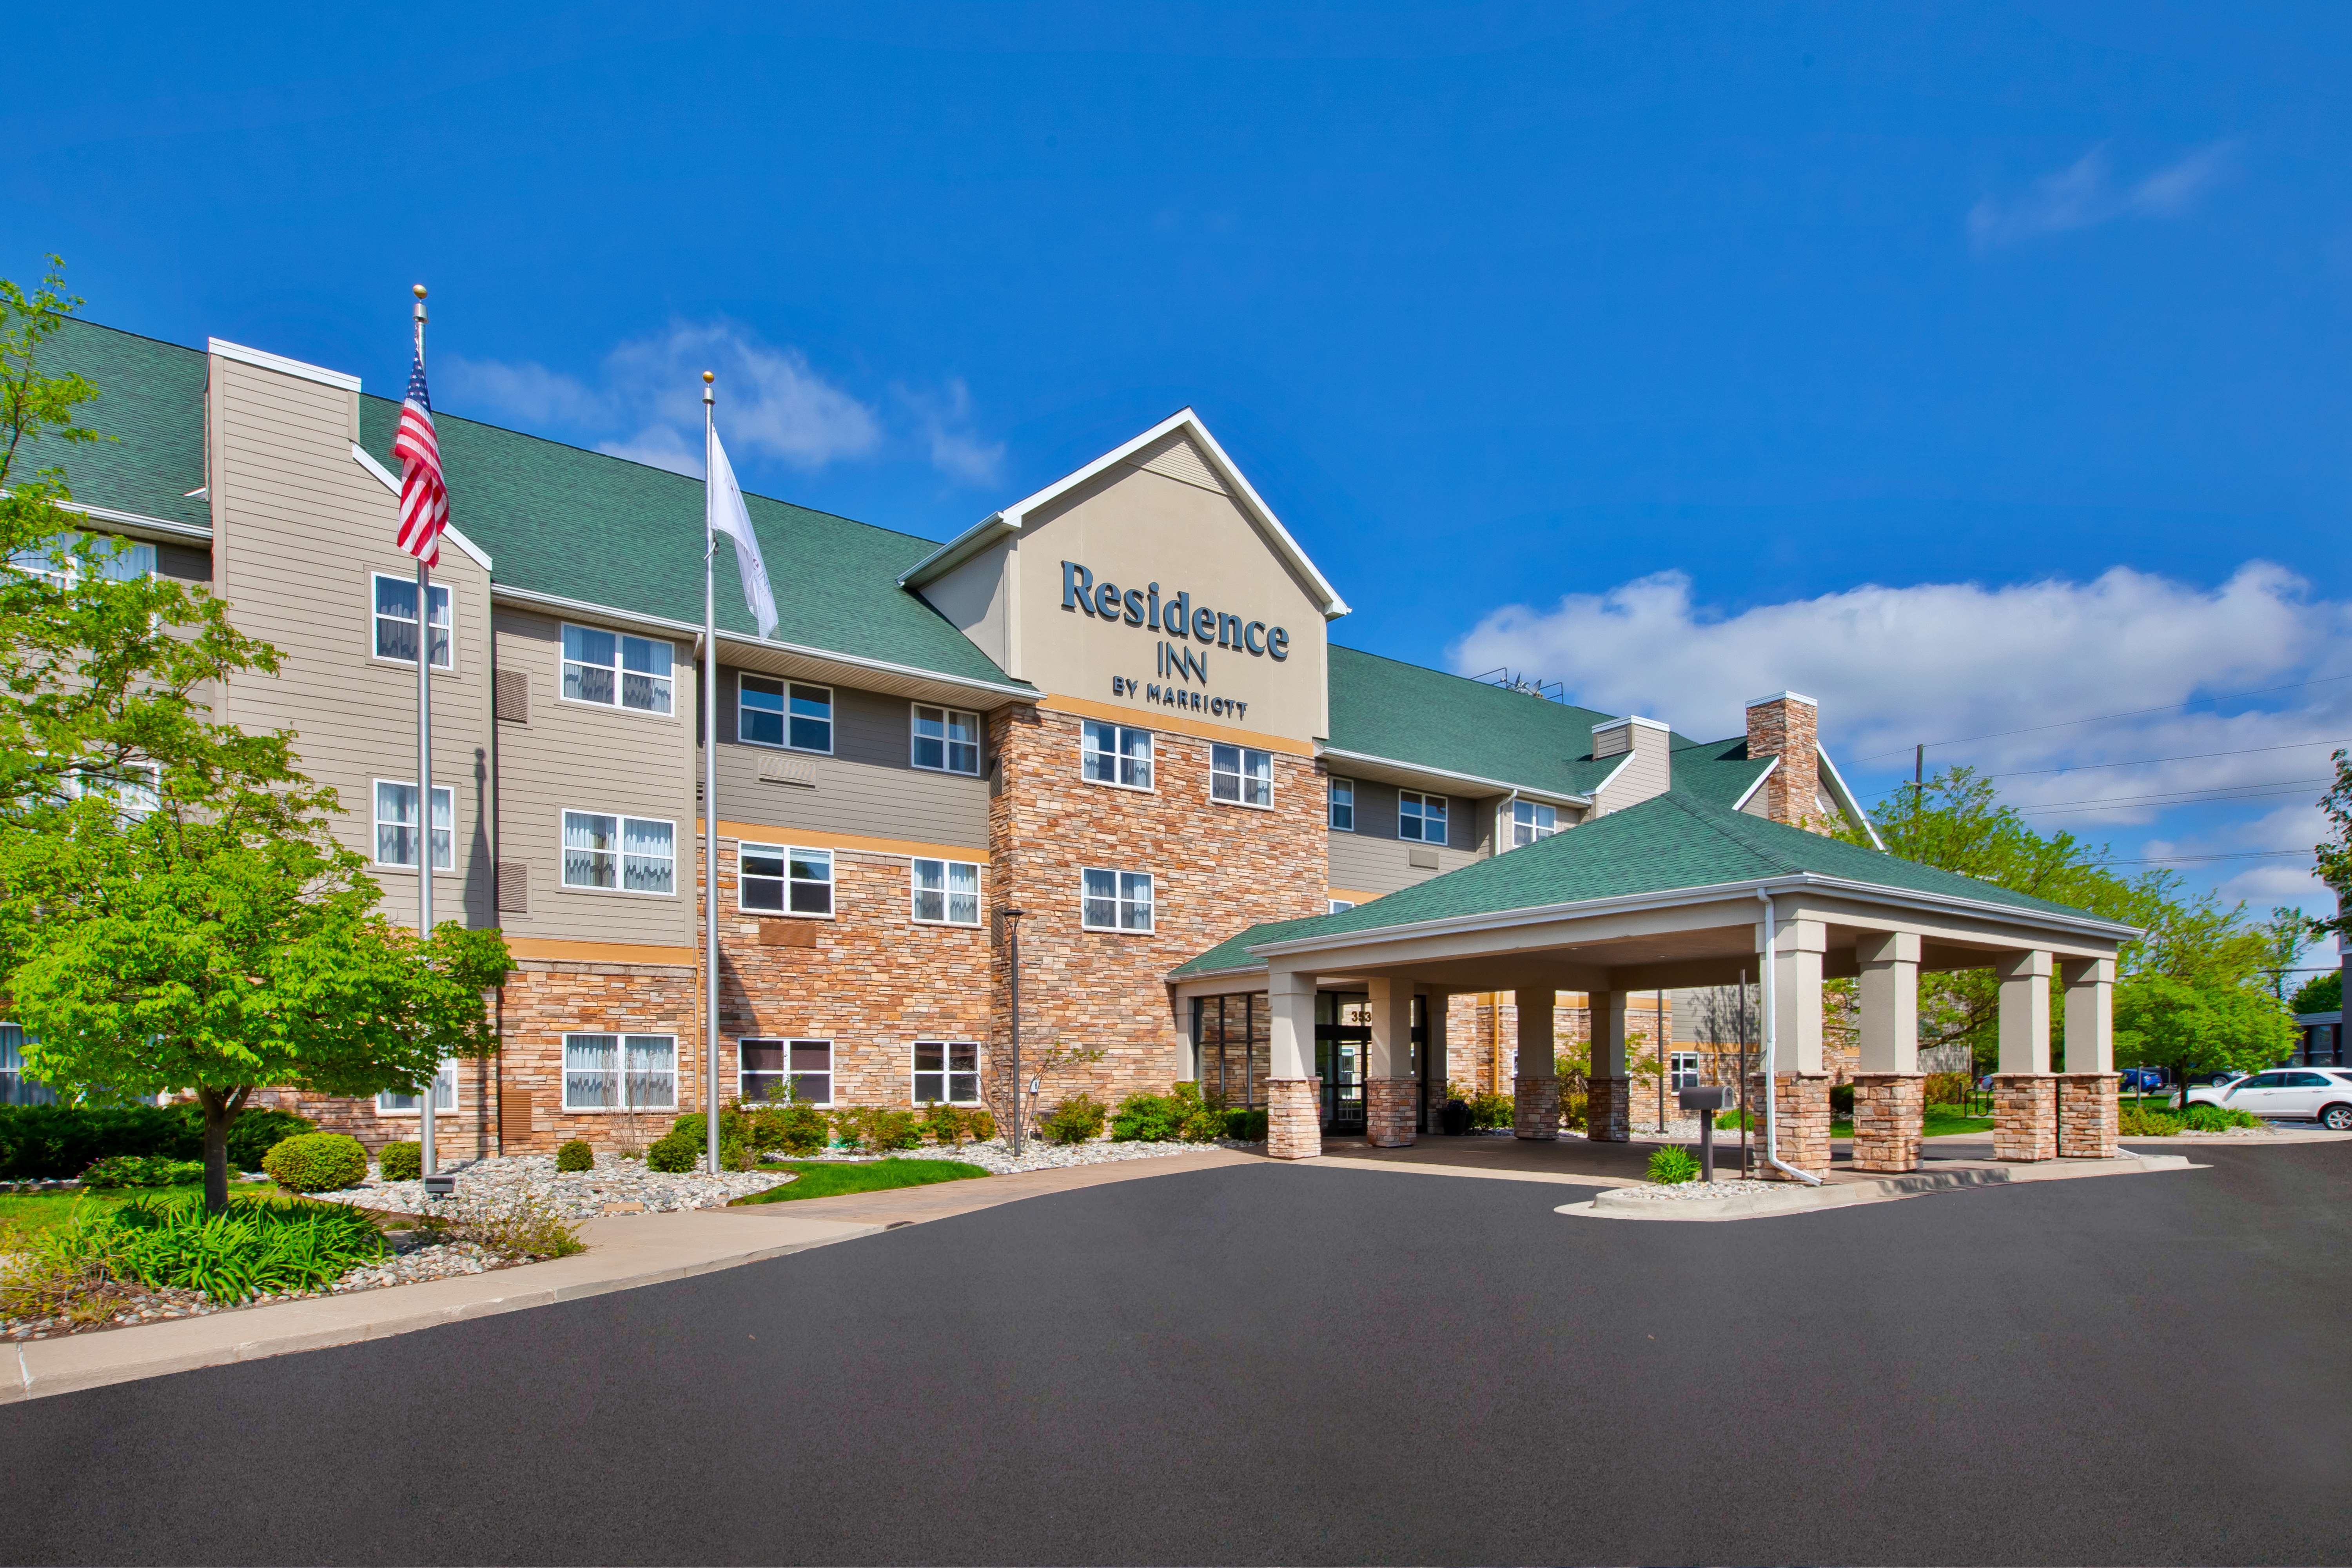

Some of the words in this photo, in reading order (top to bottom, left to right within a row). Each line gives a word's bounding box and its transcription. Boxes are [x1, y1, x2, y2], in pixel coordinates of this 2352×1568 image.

[1061, 560, 1289, 661] Residence
[1157, 641, 1207, 687] INN
[1113, 675, 1138, 699] BY
[1147, 683, 1248, 720] MARRIOTT
[1352, 1011, 1372, 1022] 353
